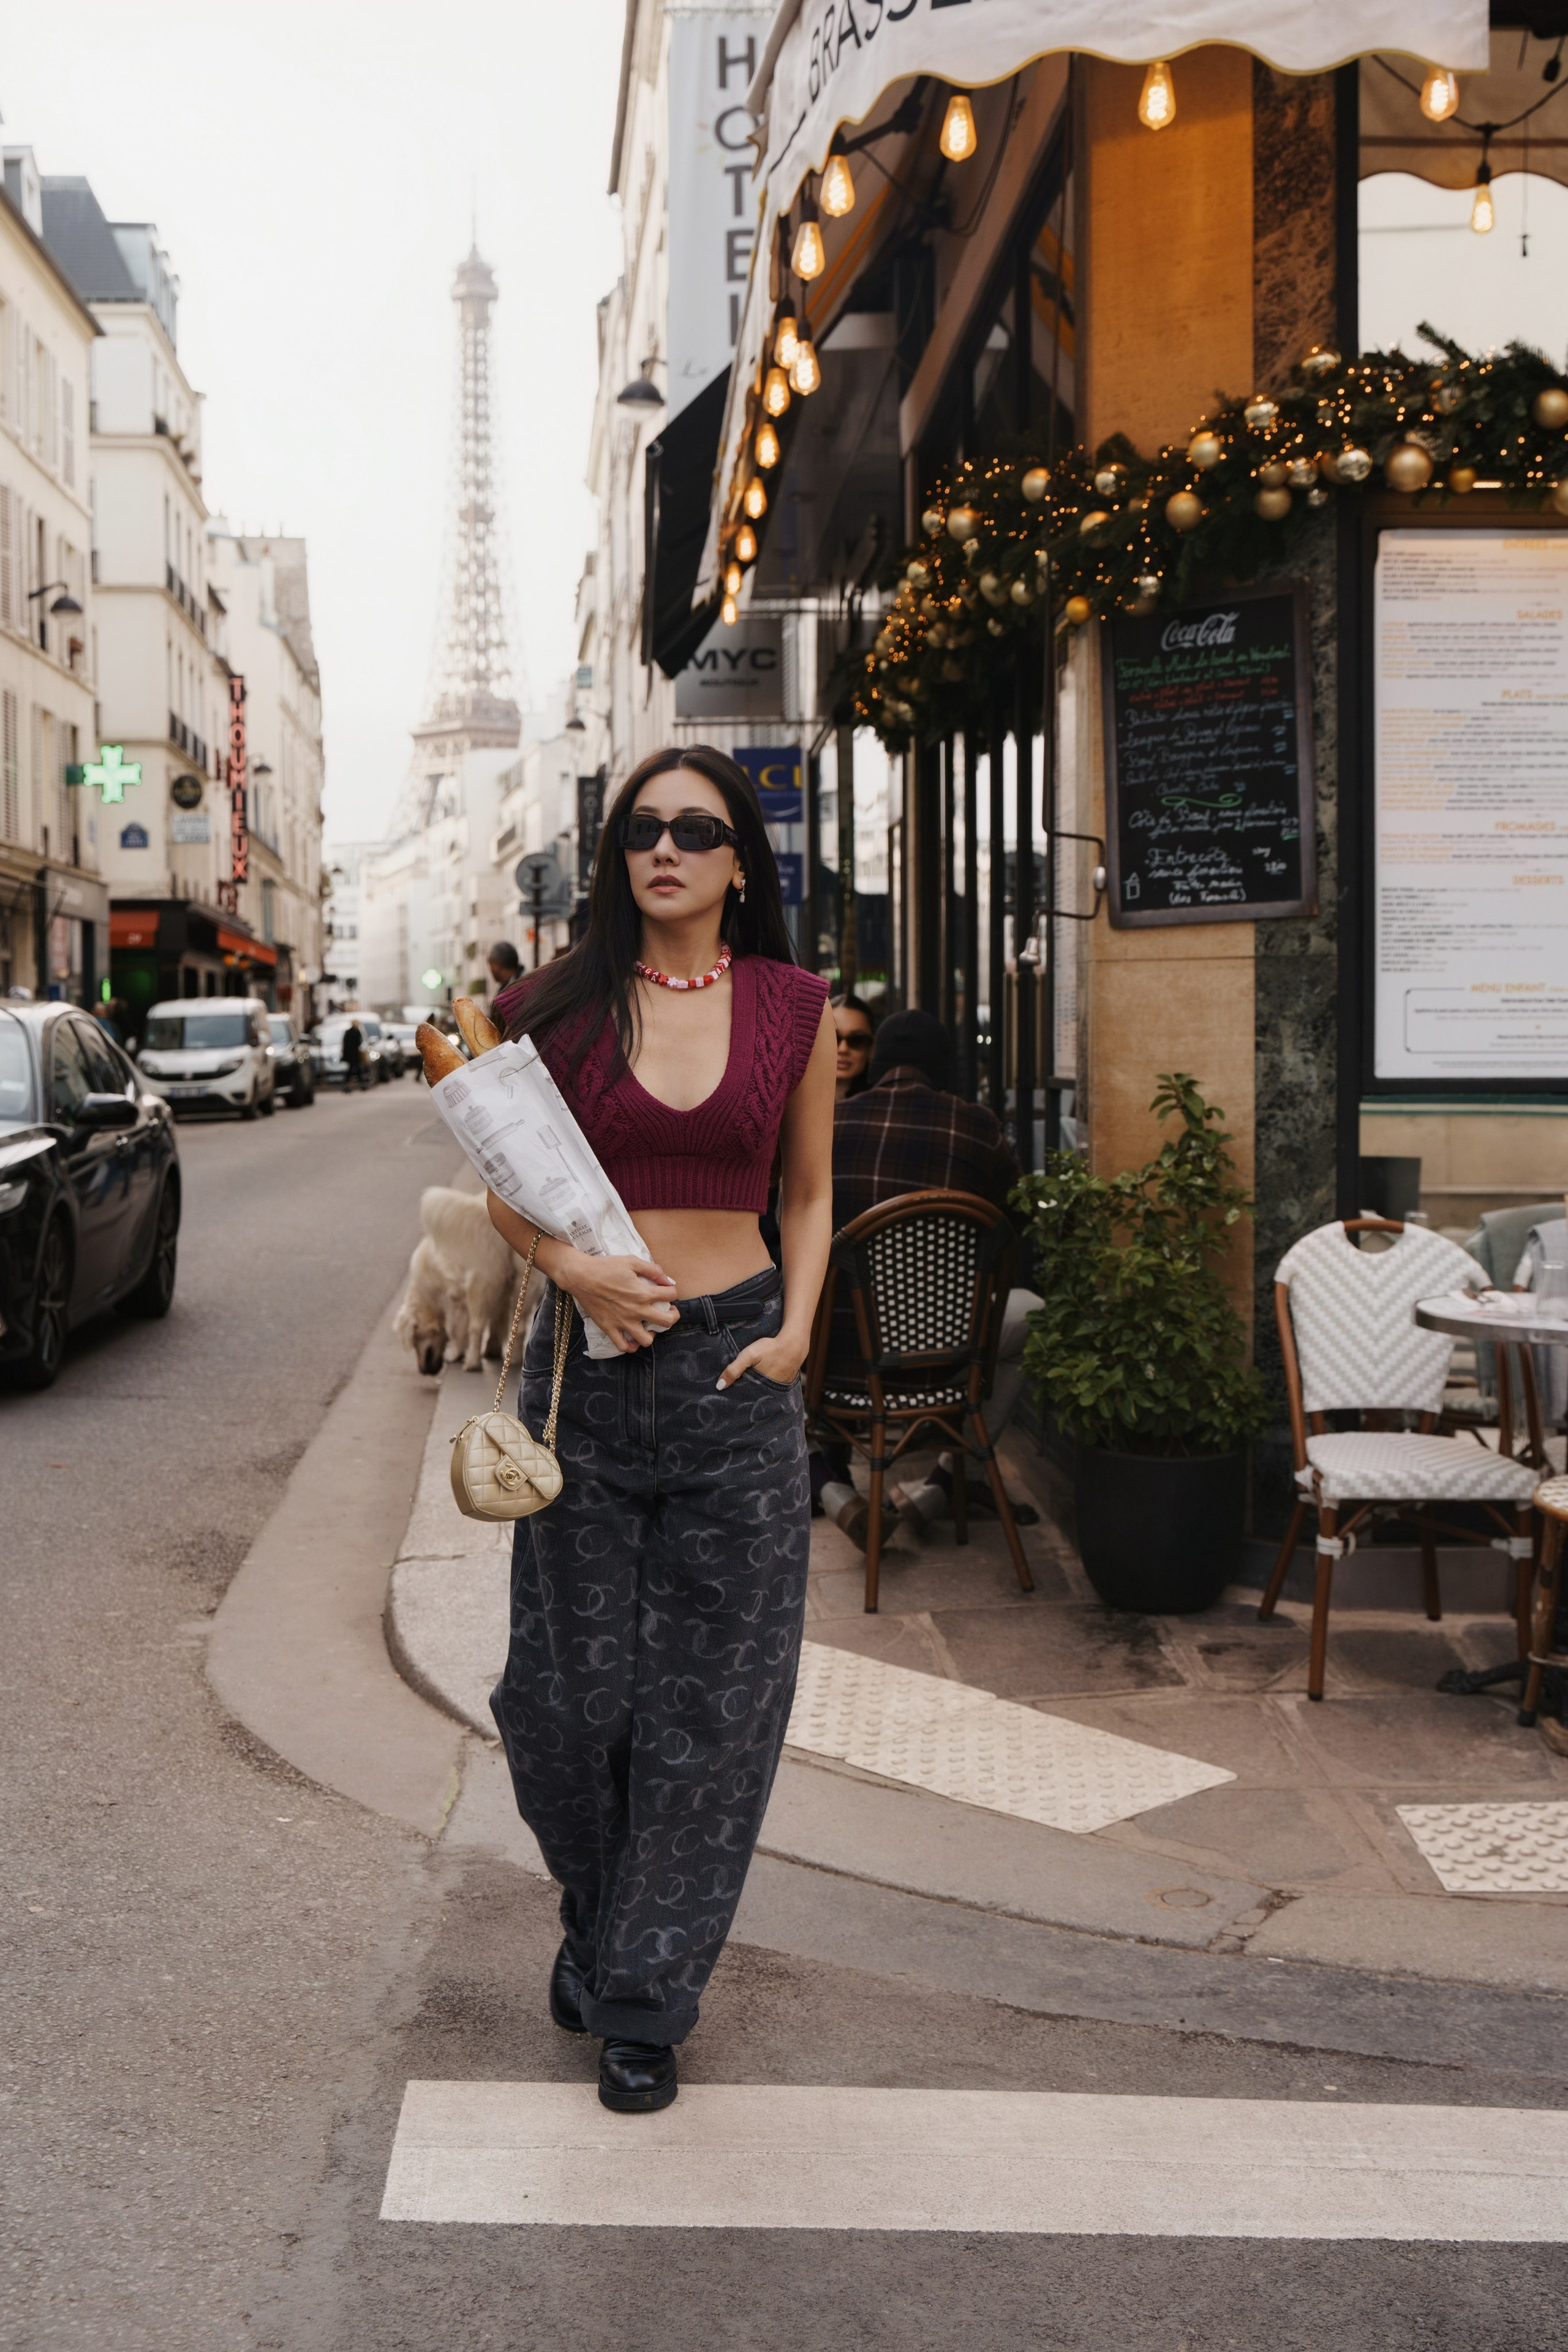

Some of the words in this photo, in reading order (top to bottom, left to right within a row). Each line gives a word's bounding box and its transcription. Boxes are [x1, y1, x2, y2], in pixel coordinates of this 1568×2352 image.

[809, 0, 973, 104] BRAS
[229, 676, 249, 883] THOUMIEUX
[1495, 821, 1556, 831] FROMAGES
[1512, 875, 1564, 886] DESSERTS
[571, 1228, 593, 1243] ULANGER
